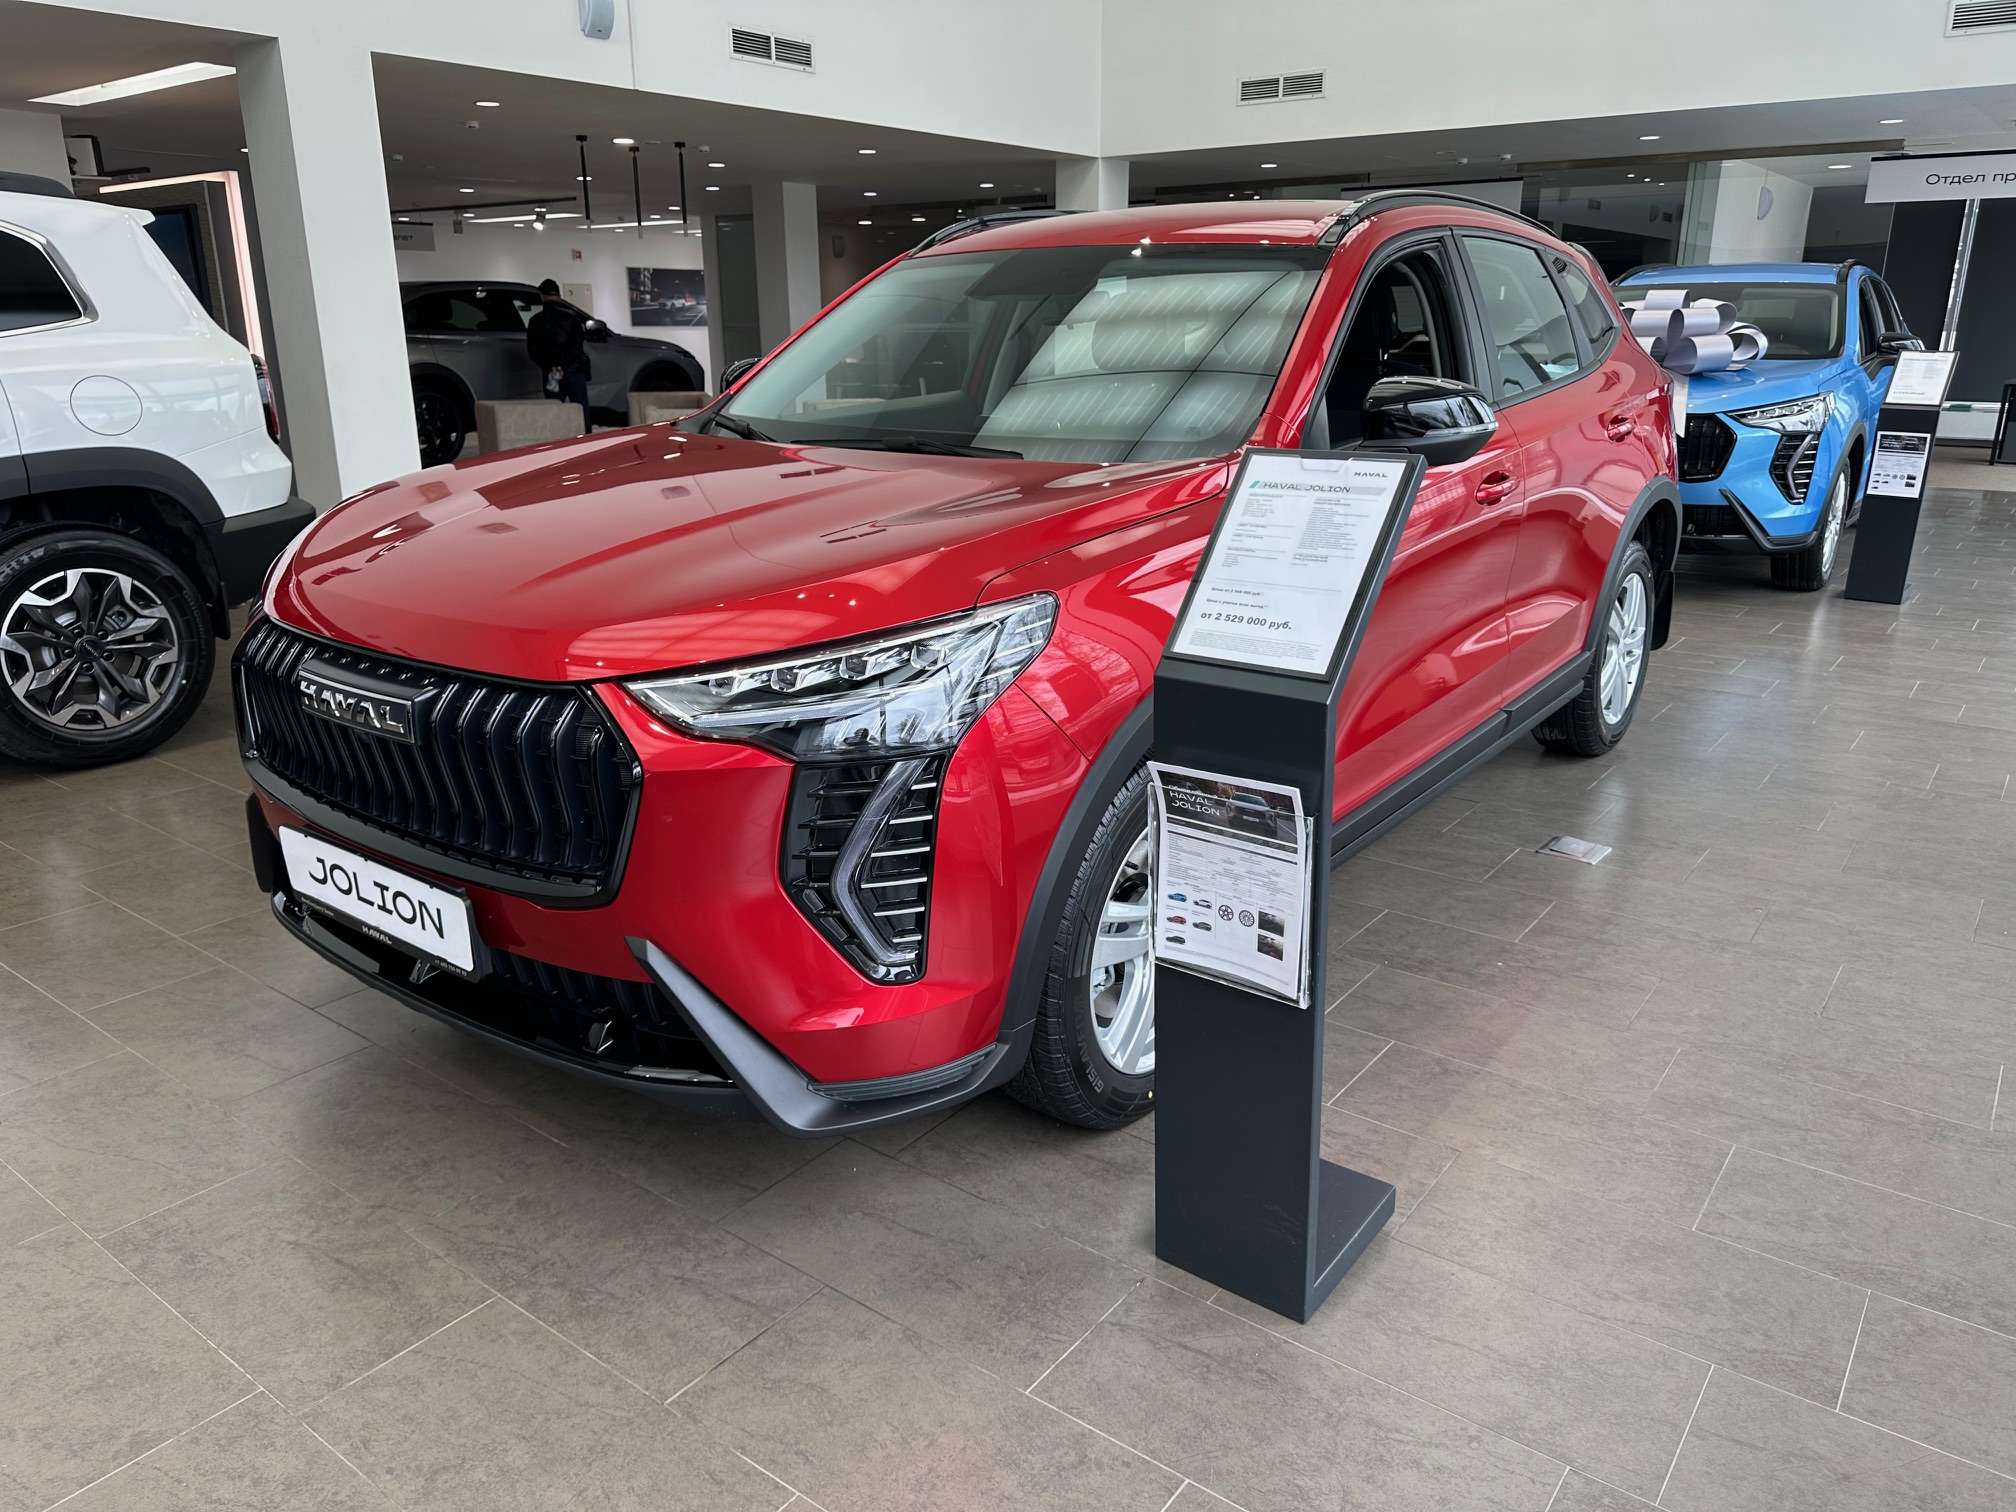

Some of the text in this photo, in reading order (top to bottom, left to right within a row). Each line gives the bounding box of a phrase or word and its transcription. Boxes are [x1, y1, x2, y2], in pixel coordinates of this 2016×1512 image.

[1925, 173, 1986, 185] Отдел
[1263, 482, 1351, 493] HAVAL JOLION
[1214, 612, 1222, 621] 2
[1224, 613, 1244, 624] 529
[1246, 616, 1267, 627] 000
[1268, 620, 1292, 631] руб.
[300, 680, 405, 734] HAVAL
[1169, 790, 1213, 806] HAVAL
[1171, 800, 1220, 816] JOLION
[308, 856, 445, 939] JOLION
[360, 924, 393, 945] HAVAL
